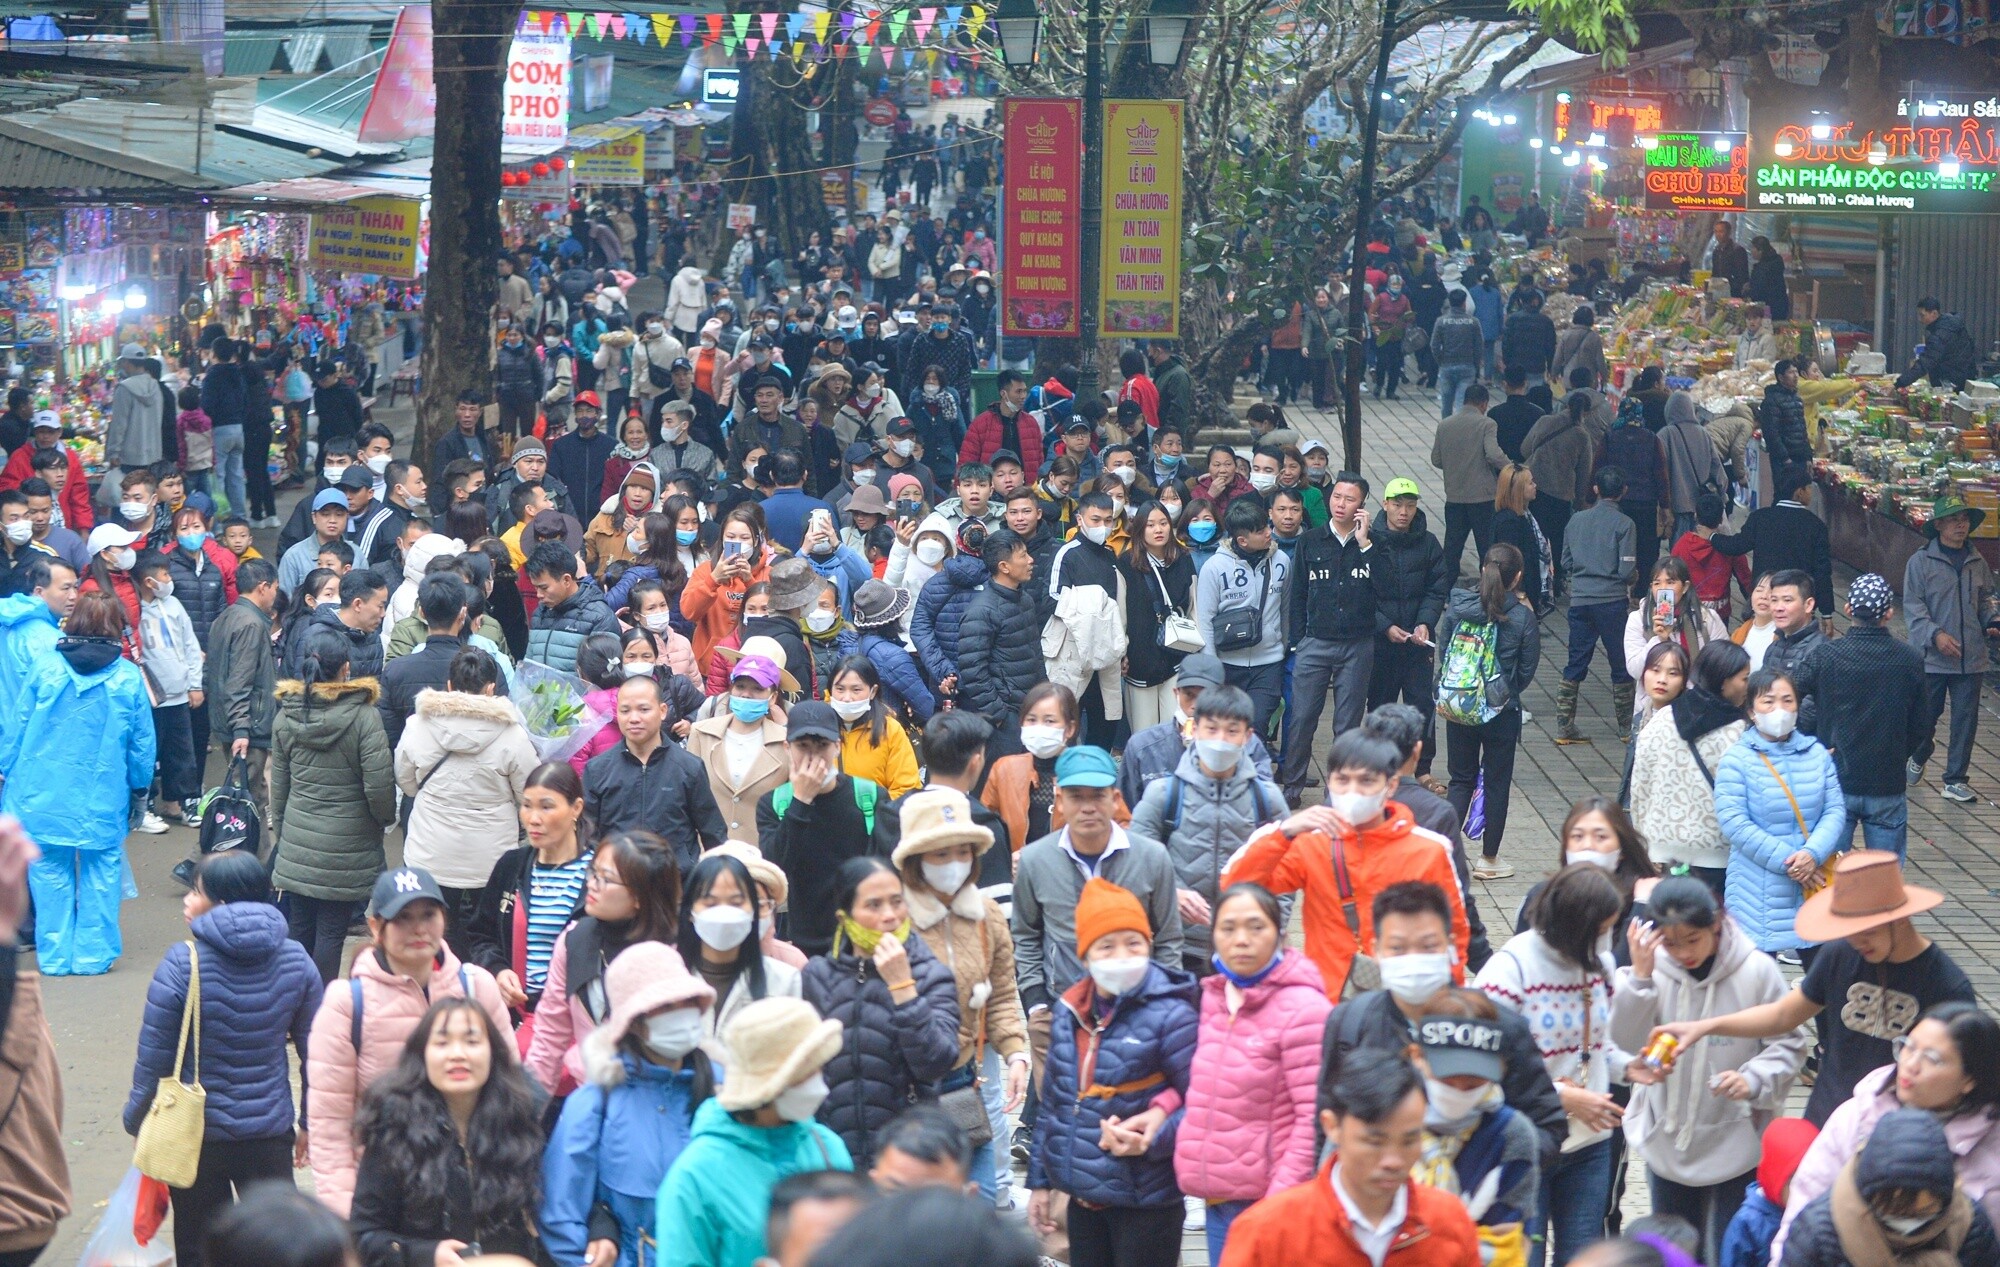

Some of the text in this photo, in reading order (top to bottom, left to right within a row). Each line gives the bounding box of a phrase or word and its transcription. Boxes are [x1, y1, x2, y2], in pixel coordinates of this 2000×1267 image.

[508, 60, 563, 86] CƠM
[508, 87, 562, 118] PHỞ
[1935, 100, 1969, 117] Rau
[1973, 97, 2000, 117] Sắ
[1646, 145, 1678, 168] RAU
[1680, 141, 1723, 168] SẮN
[1129, 160, 1156, 187] LỄ HỘI
[1646, 166, 1703, 194] CHỦ
[1757, 163, 1795, 187] SẢN
[1799, 163, 1851, 188] PHẨM
[1855, 166, 1896, 191] ĐỘC
[1017, 185, 1067, 202] CHÙA HƯƠNG
[1115, 190, 1169, 210] CHÙA HƯƠNG
[1845, 193, 1875, 206] Chùa
[1020, 207, 1063, 225] KÍNH CHÚC
[1123, 217, 1160, 237] AN TOÀN
[1019, 229, 1063, 247] QUÝ KHÁCH
[1021, 254, 1061, 269] AN KHANG
[1119, 244, 1162, 264] VĂN MINH
[1016, 275, 1067, 294] THỊNH VƯỢNG
[1116, 271, 1165, 295] THÂN THIỆN
[1421, 1021, 1503, 1052] SPORT
